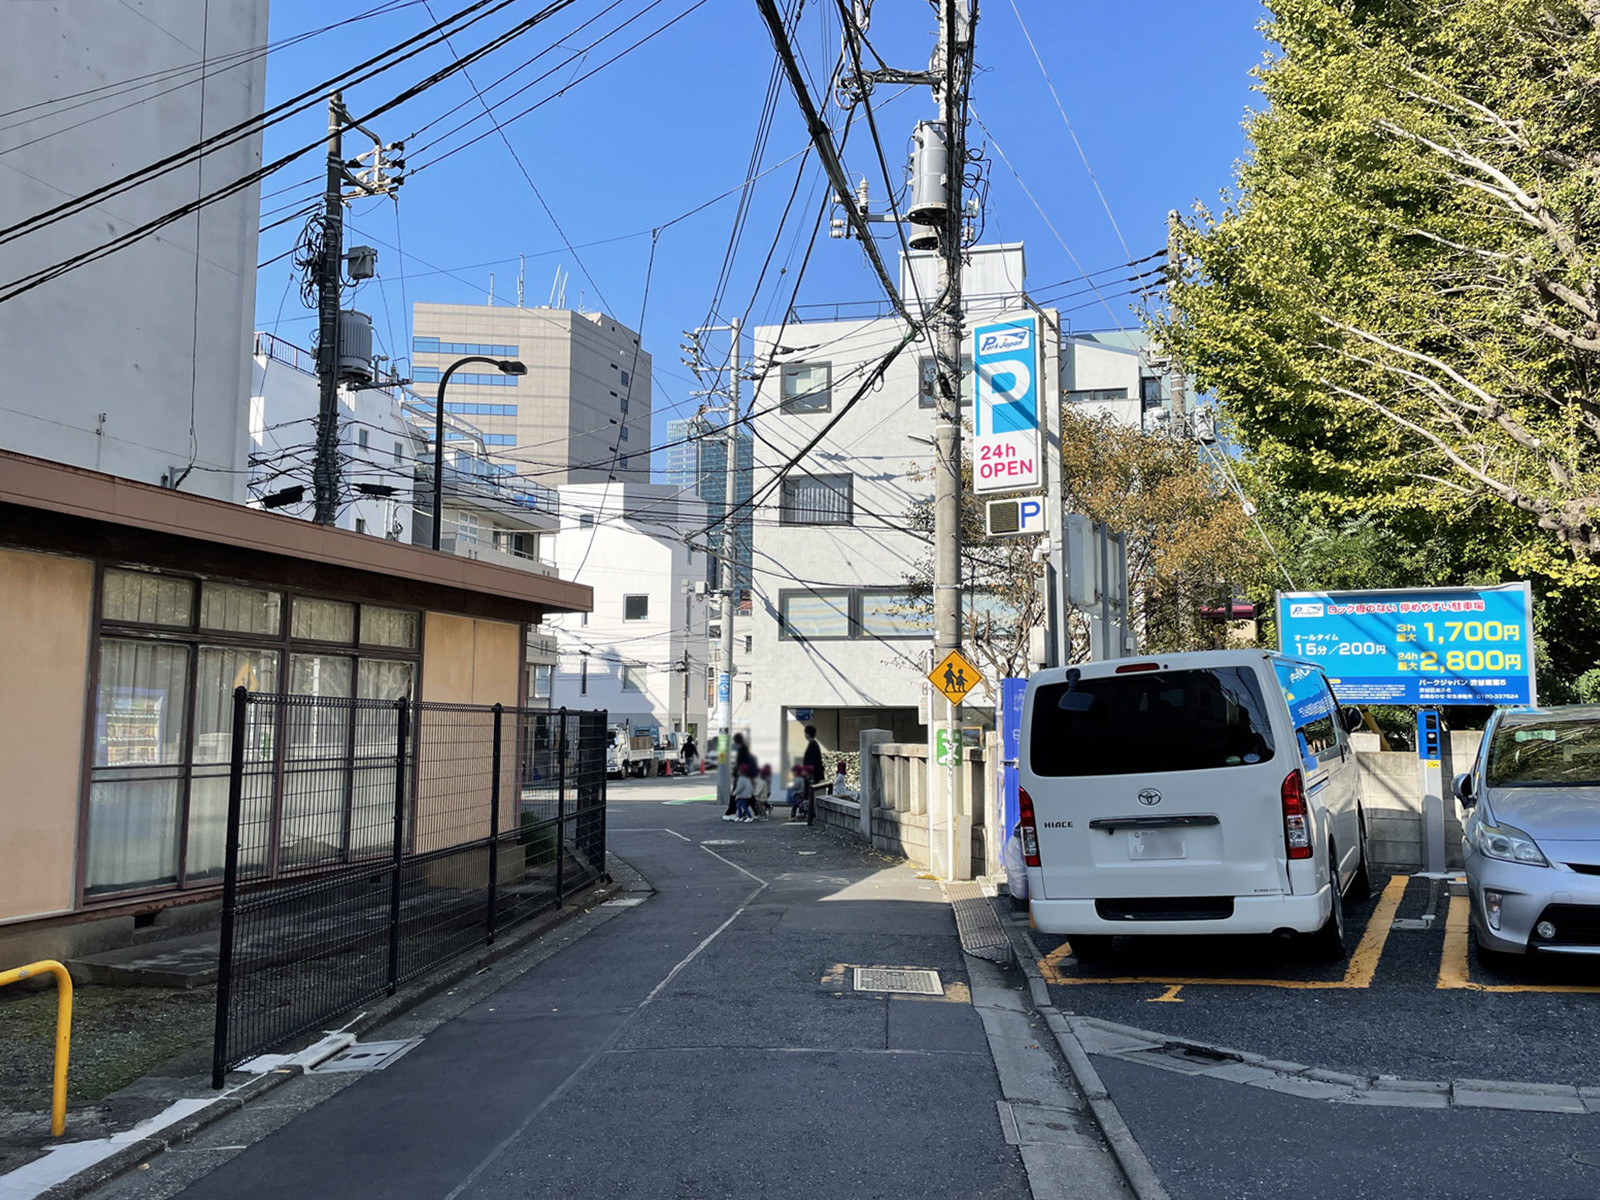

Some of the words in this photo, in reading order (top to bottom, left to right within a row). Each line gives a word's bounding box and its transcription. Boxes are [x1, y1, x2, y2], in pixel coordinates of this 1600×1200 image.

[981, 336, 998, 352] Park
[999, 338, 1023, 350] Japan
[980, 360, 1031, 436] P
[980, 443, 1016, 461] 24h
[980, 459, 1033, 479] OPEN
[1021, 501, 1041, 529] P
[1396, 624, 1416, 632] 3h
[1424, 621, 1520, 644] 1,700円
[1294, 633, 1339, 642] オールタイム
[1397, 652, 1418, 660] 24h
[1420, 650, 1521, 673] 2,800円
[1043, 821, 1074, 829] HIACE
